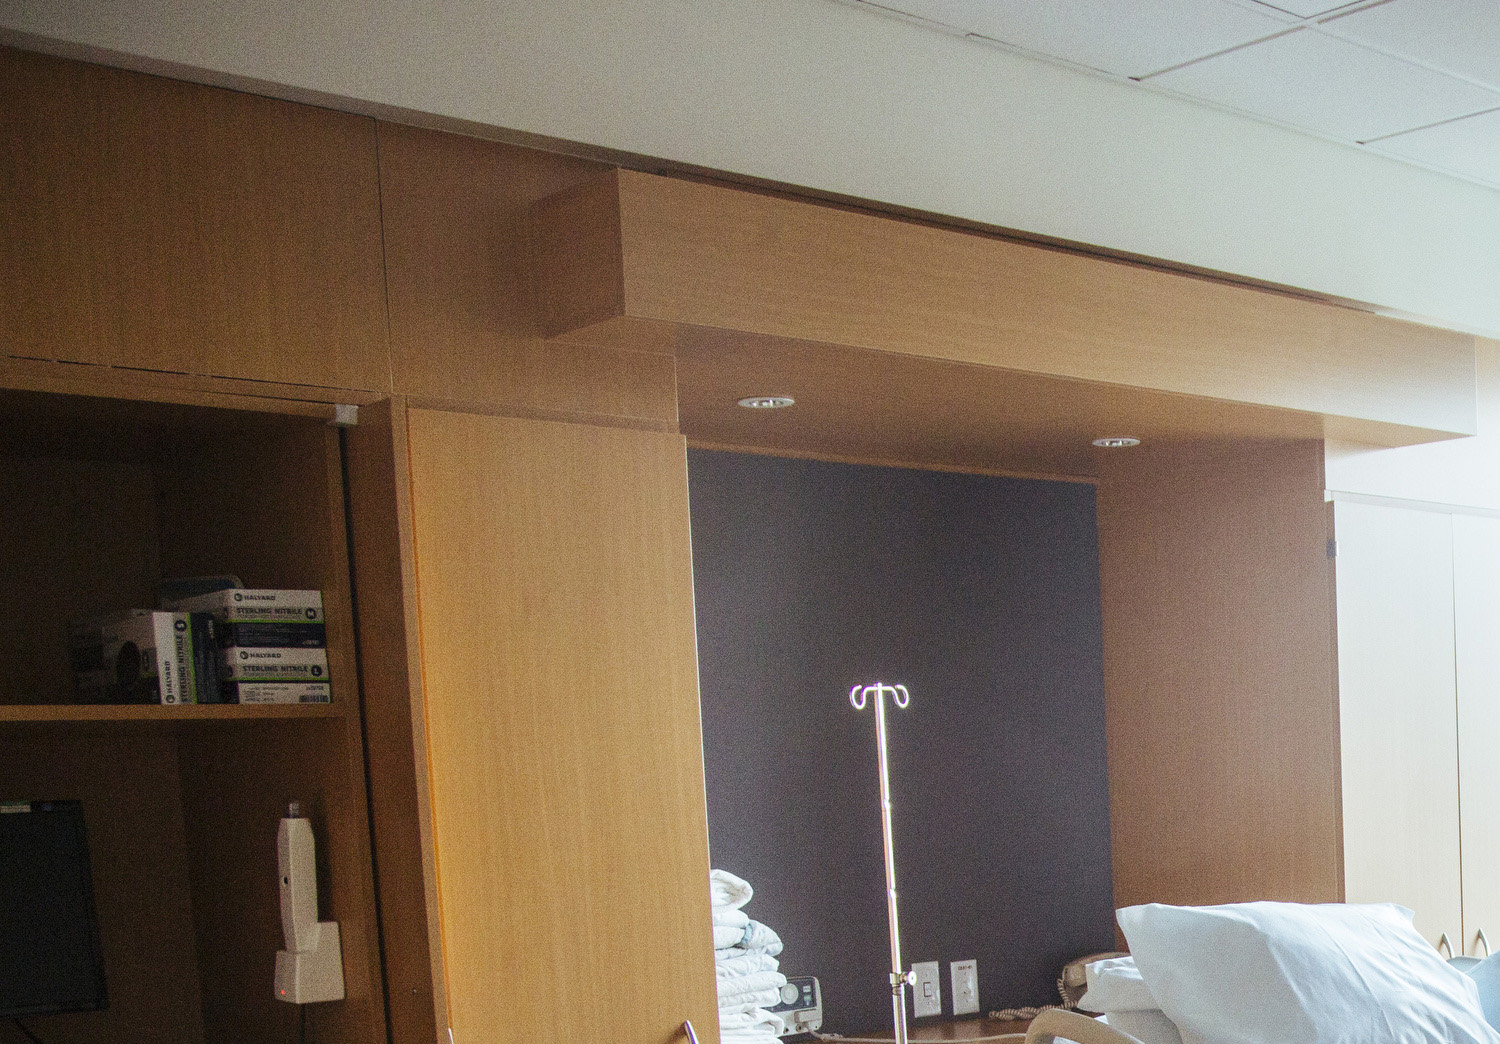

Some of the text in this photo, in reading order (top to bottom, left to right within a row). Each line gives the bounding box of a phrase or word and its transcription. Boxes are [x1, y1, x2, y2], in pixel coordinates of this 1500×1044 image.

[164, 661, 173, 693] HALYARD
[176, 635, 188, 702] STERLING NITRILE
